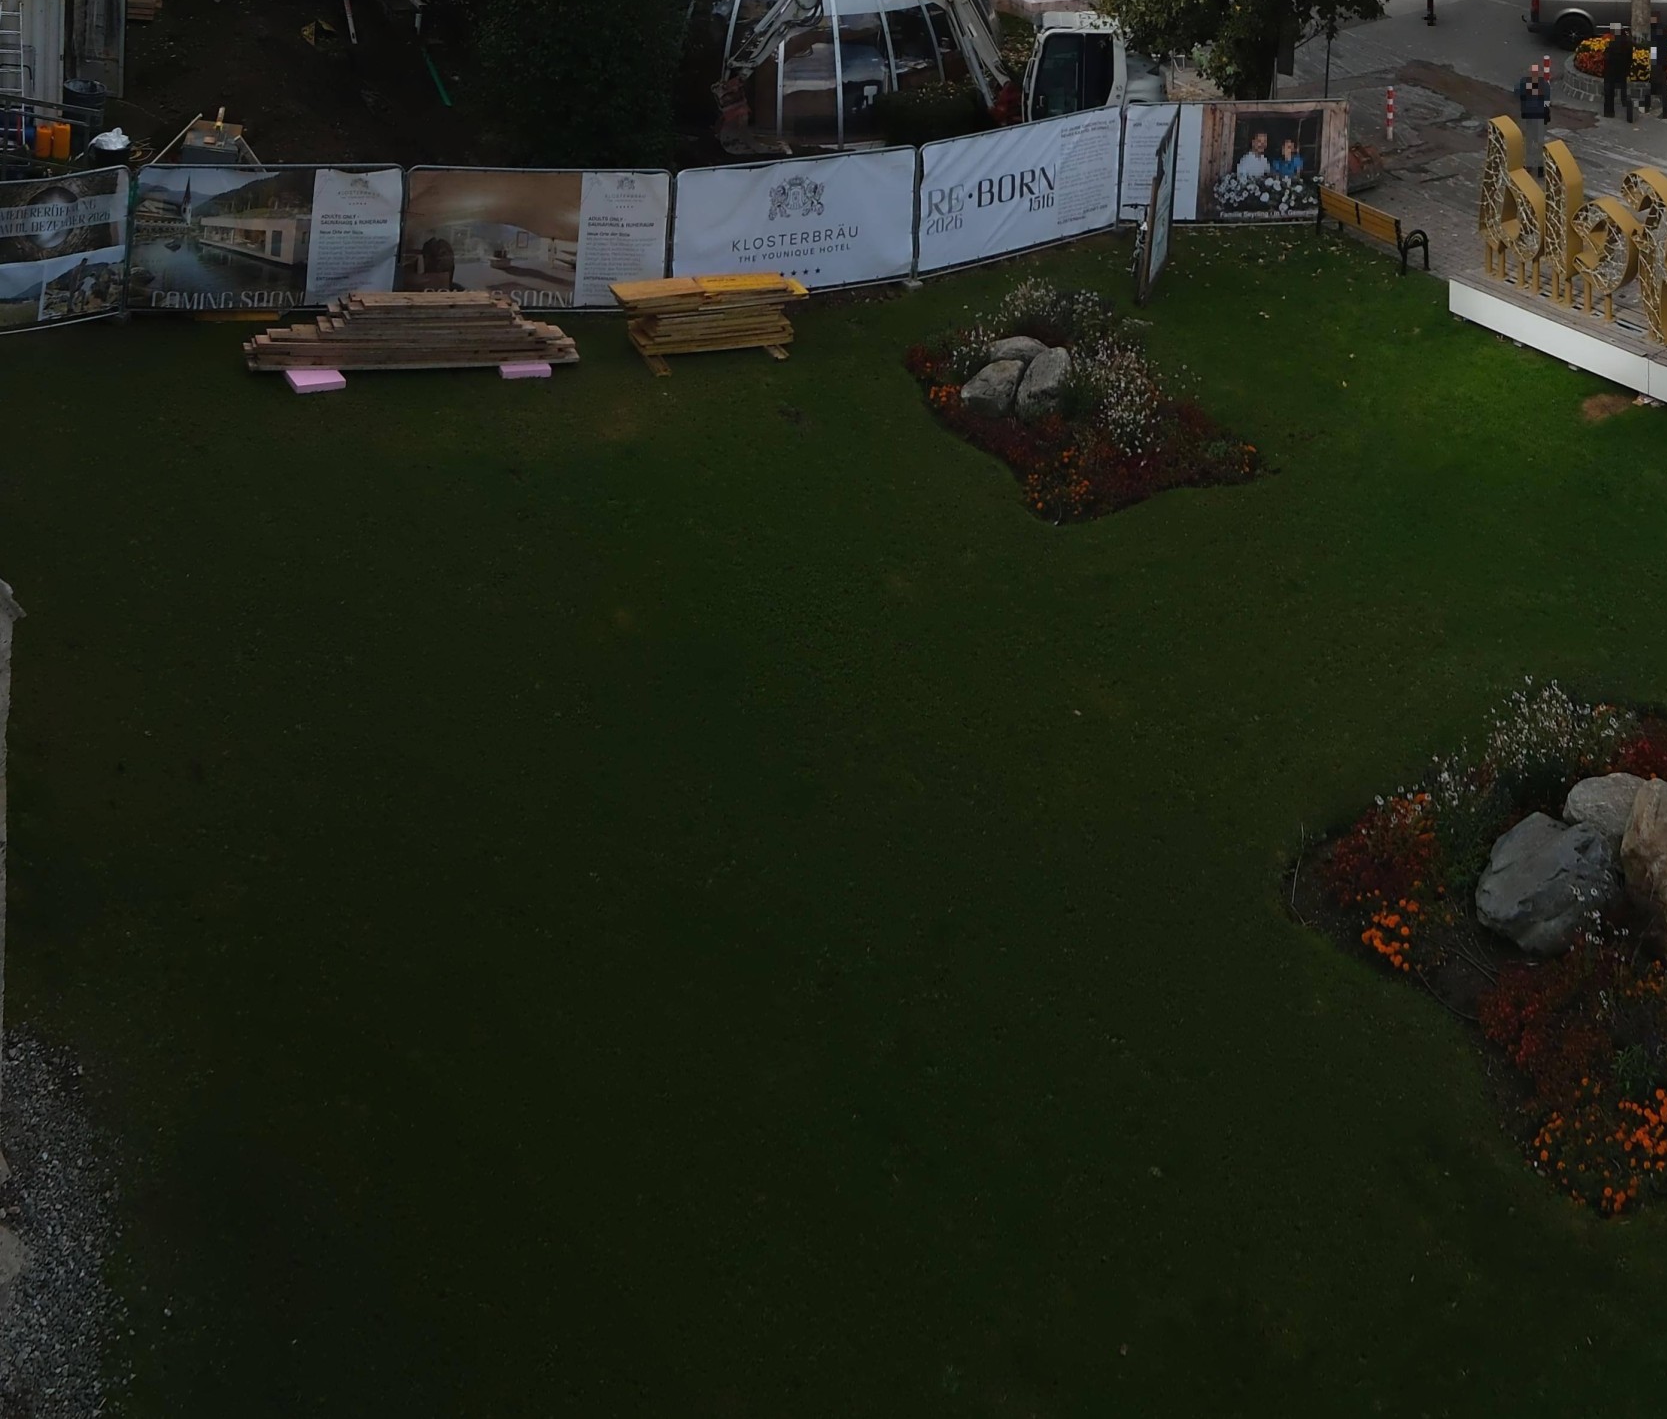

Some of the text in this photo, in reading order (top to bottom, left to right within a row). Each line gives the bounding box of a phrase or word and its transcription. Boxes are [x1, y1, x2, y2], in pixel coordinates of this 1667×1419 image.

[1030, 192, 1055, 212] 1516
[927, 213, 963, 236] 2026
[732, 223, 858, 252] KLOSTERBRÄU
[739, 243, 851, 264] THE YOUNIQUE HOTEL
